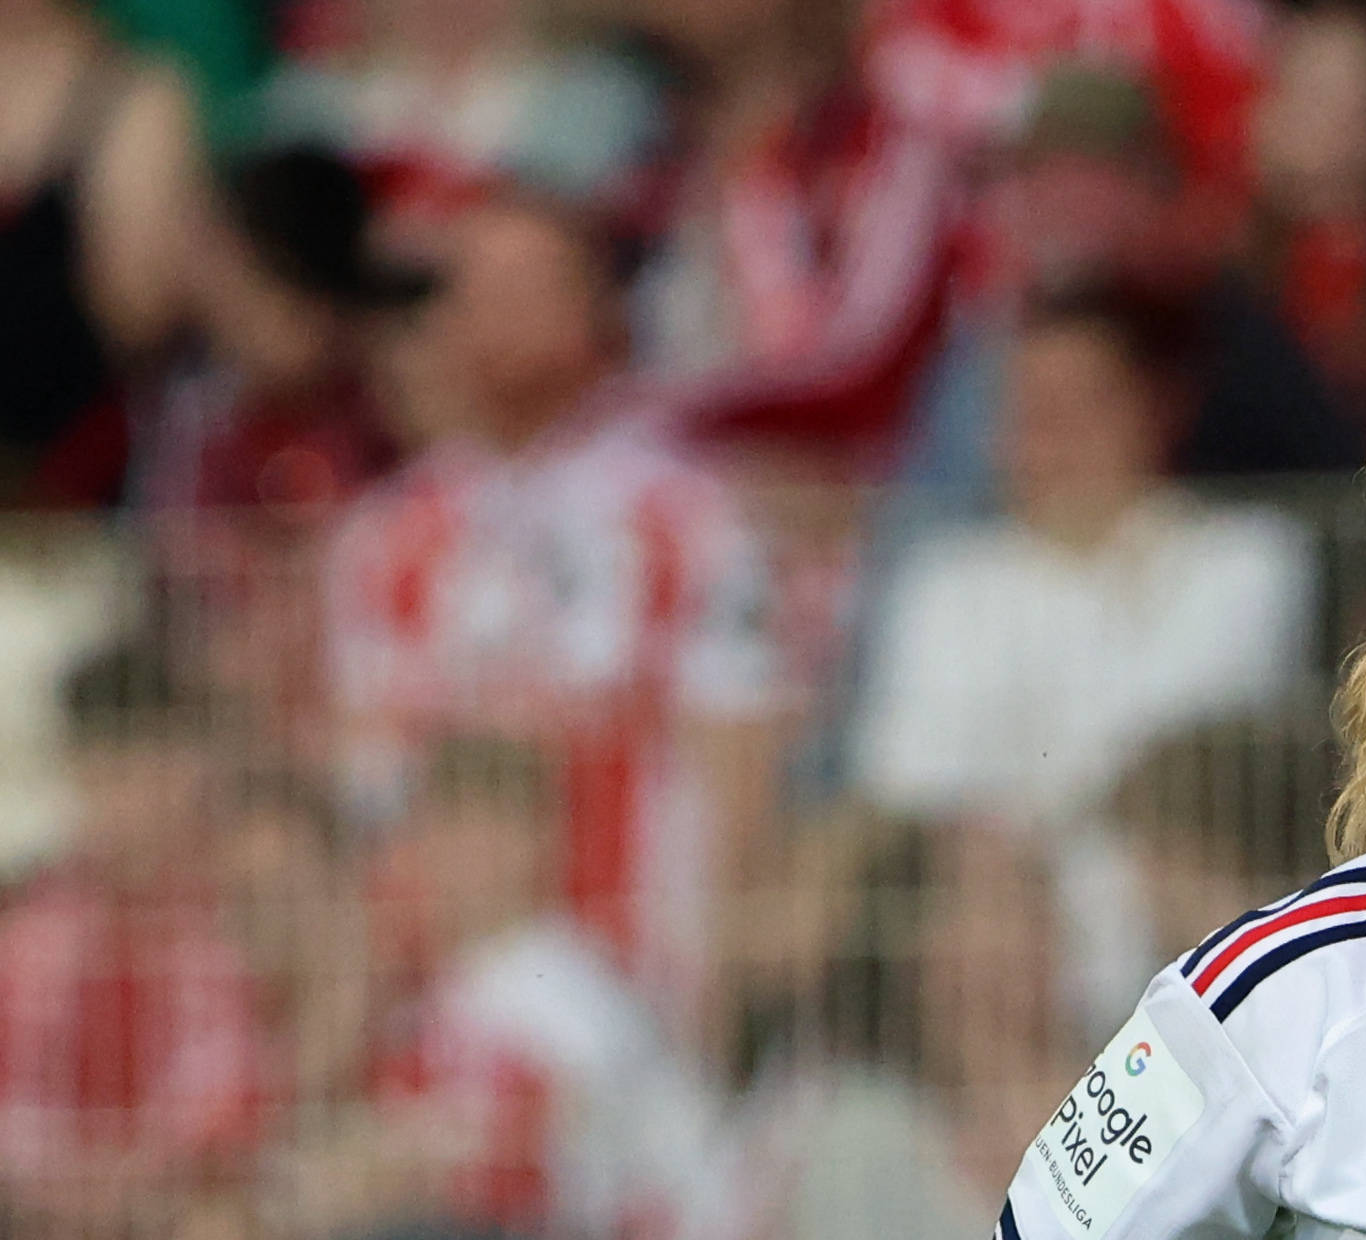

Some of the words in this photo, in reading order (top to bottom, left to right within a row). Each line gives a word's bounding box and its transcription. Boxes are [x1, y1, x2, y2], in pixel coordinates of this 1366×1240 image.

[1050, 1095, 1108, 1187] Pixel
[1085, 1064, 1153, 1164] oogle
[1035, 1137, 1093, 1230] UEN-BUNDESLIGA
